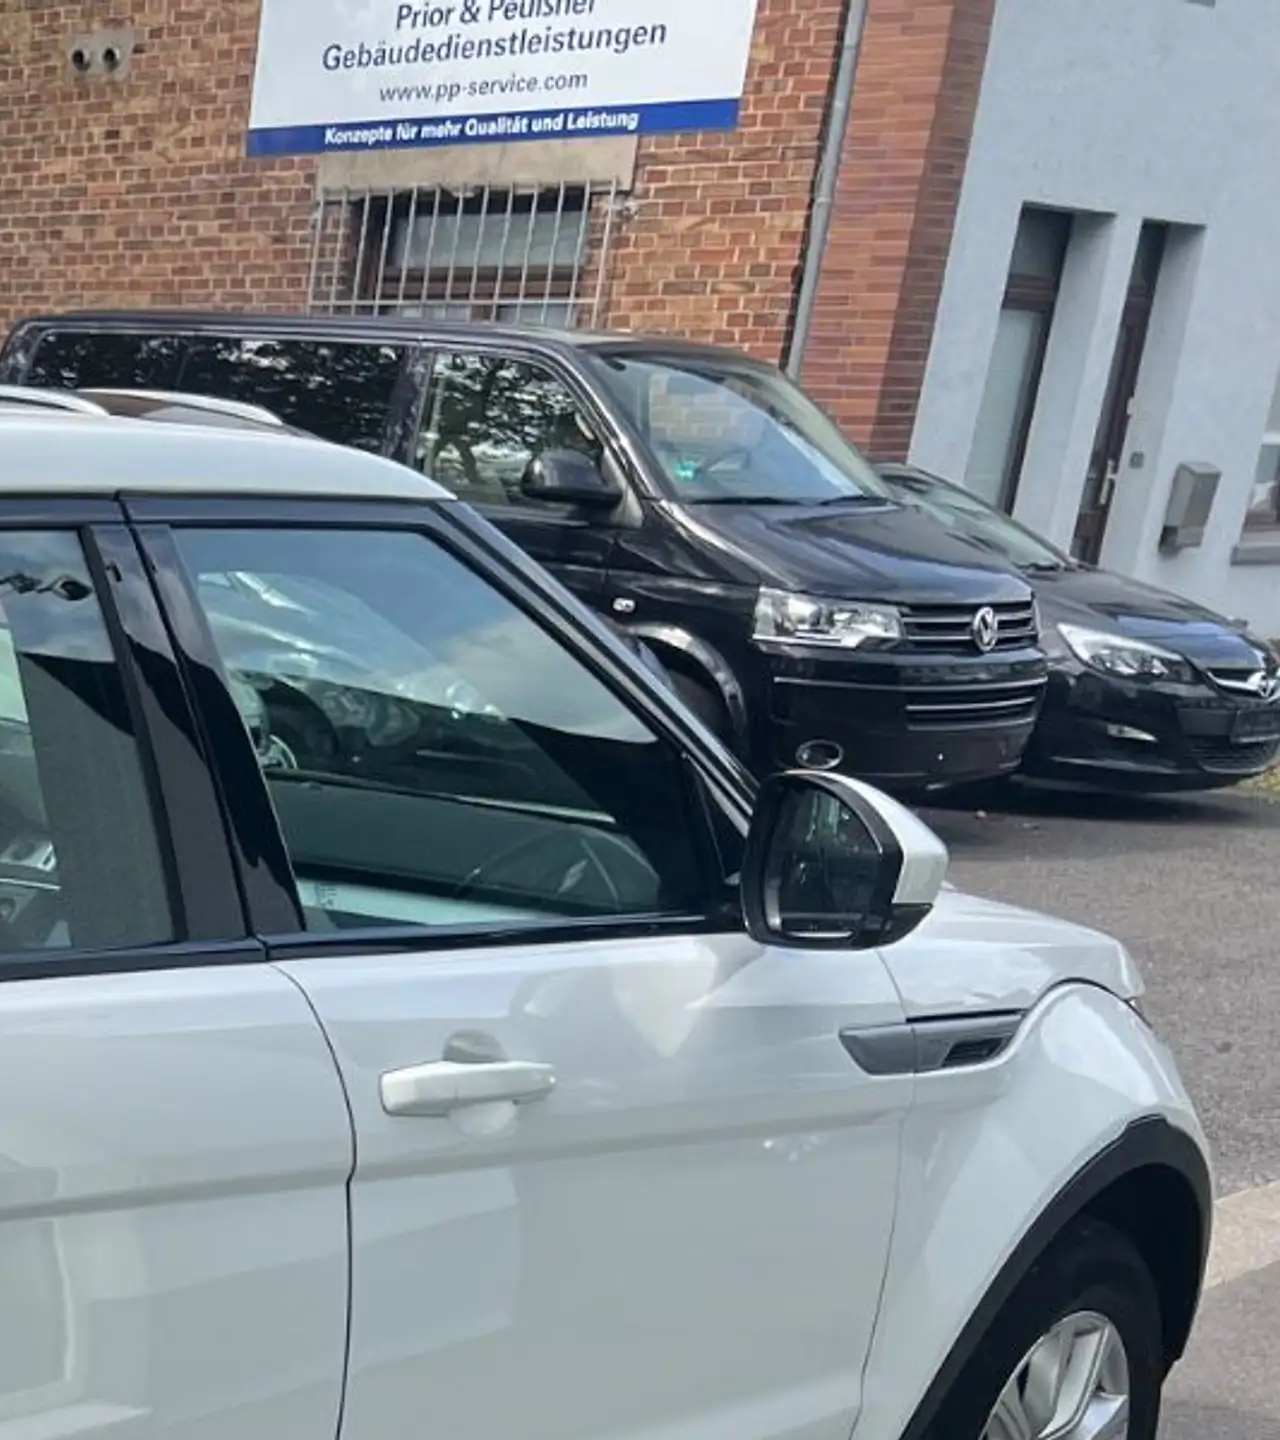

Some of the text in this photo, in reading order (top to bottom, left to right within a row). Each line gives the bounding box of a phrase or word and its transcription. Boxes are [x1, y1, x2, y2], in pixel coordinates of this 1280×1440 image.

[396, 2, 455, 30] Prior
[459, 0, 481, 24] &
[322, 23, 668, 70] Gebäudedienstleistungen
[379, 71, 589, 103] www.pp-service.com
[324, 110, 639, 146] Konzepte für mehr Qualität und Leistung
